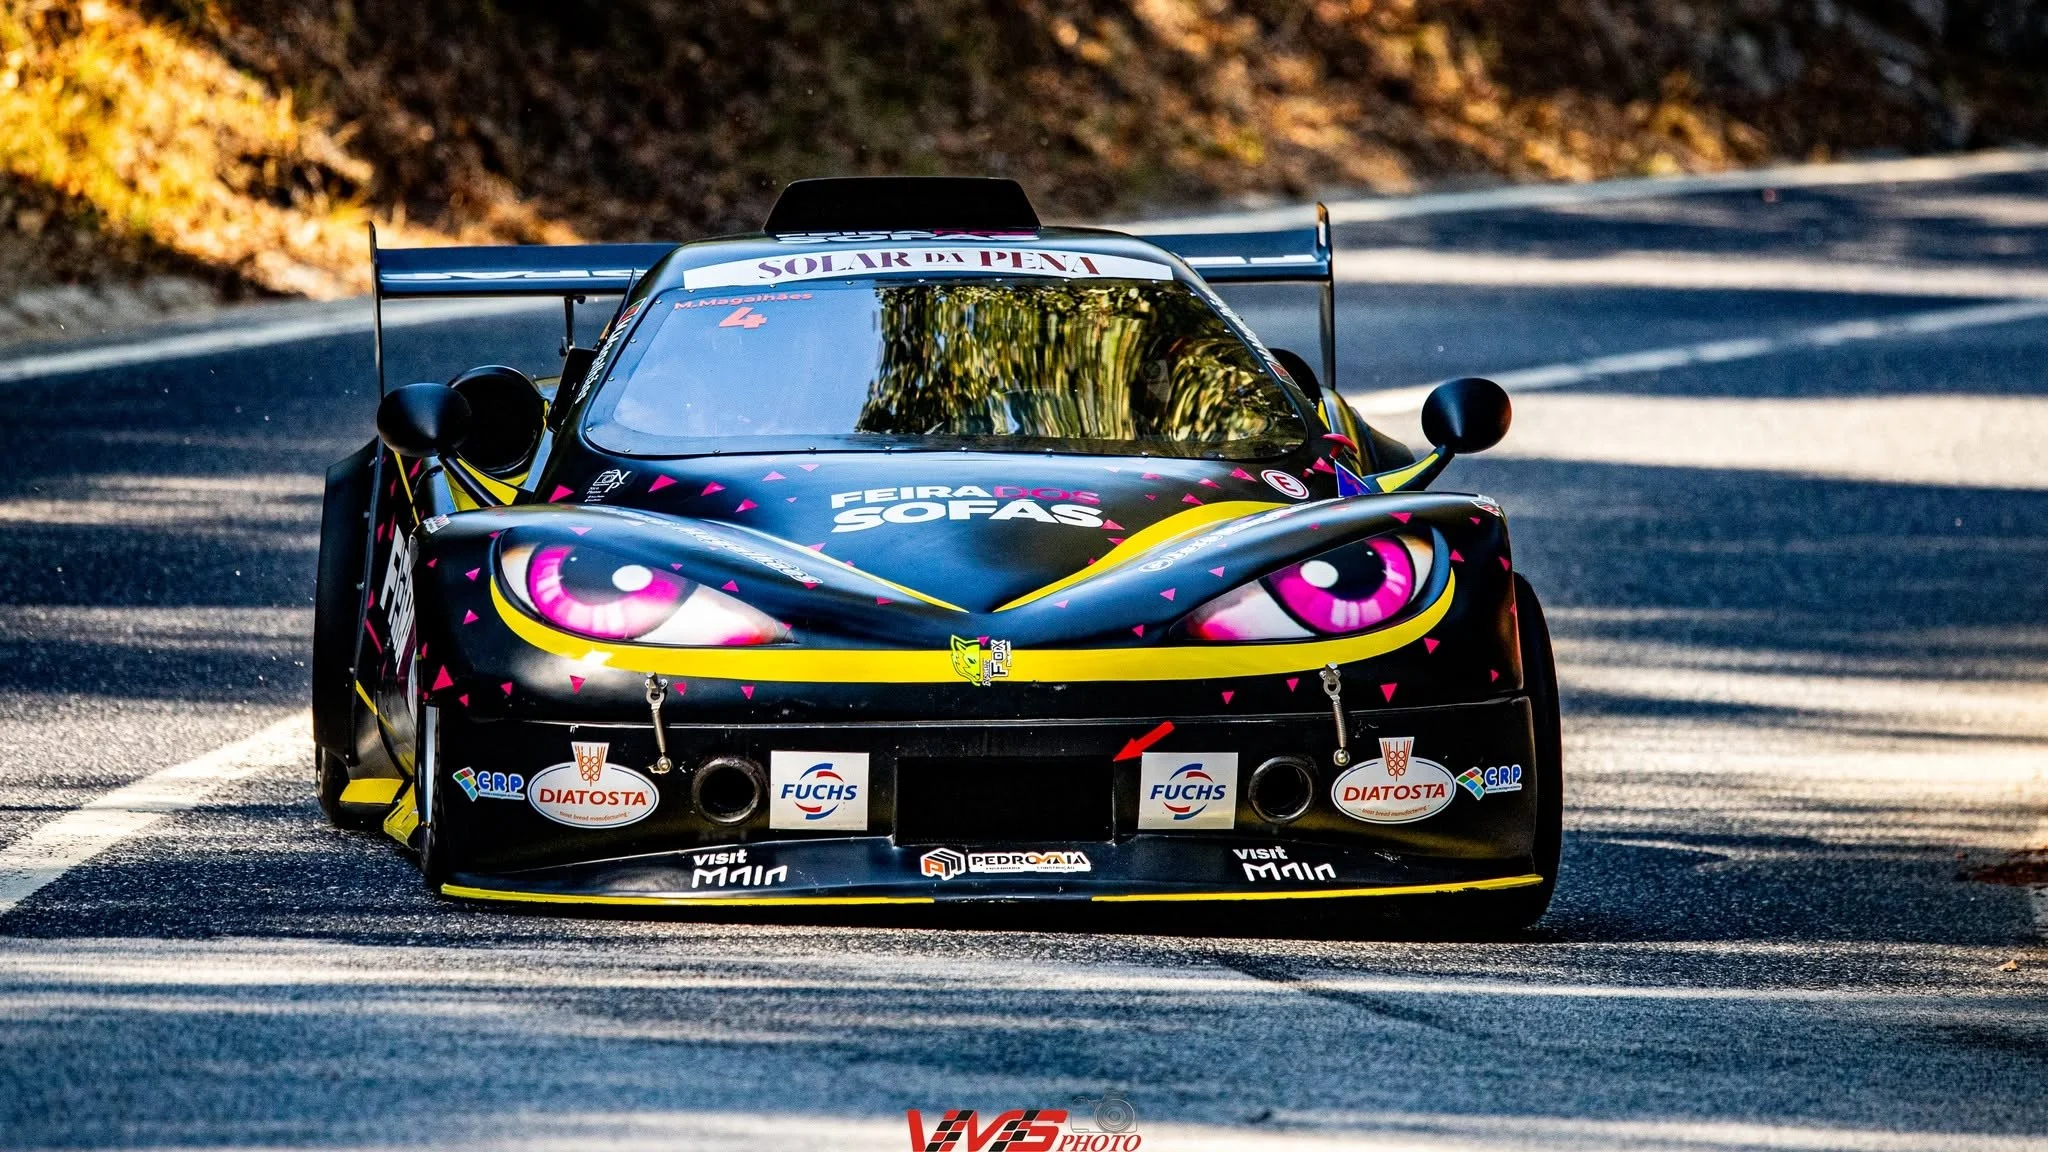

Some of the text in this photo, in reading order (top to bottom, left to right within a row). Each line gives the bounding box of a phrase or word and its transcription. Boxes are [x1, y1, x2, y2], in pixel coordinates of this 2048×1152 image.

[758, 251, 1101, 278] SOLAR DA PENA
[718, 306, 768, 329] 4
[1272, 475, 1298, 493] E
[831, 498, 1103, 533] SOFÁS
[477, 771, 525, 792] CRP
[1485, 764, 1522, 787] CRP
[539, 788, 648, 806] DIATOSTA
[781, 783, 857, 801] FUCHS
[1150, 784, 1227, 801] FUCHS
[1343, 783, 1446, 802] DIATOSTA
[692, 849, 748, 866] visit
[1233, 845, 1288, 860] visit
